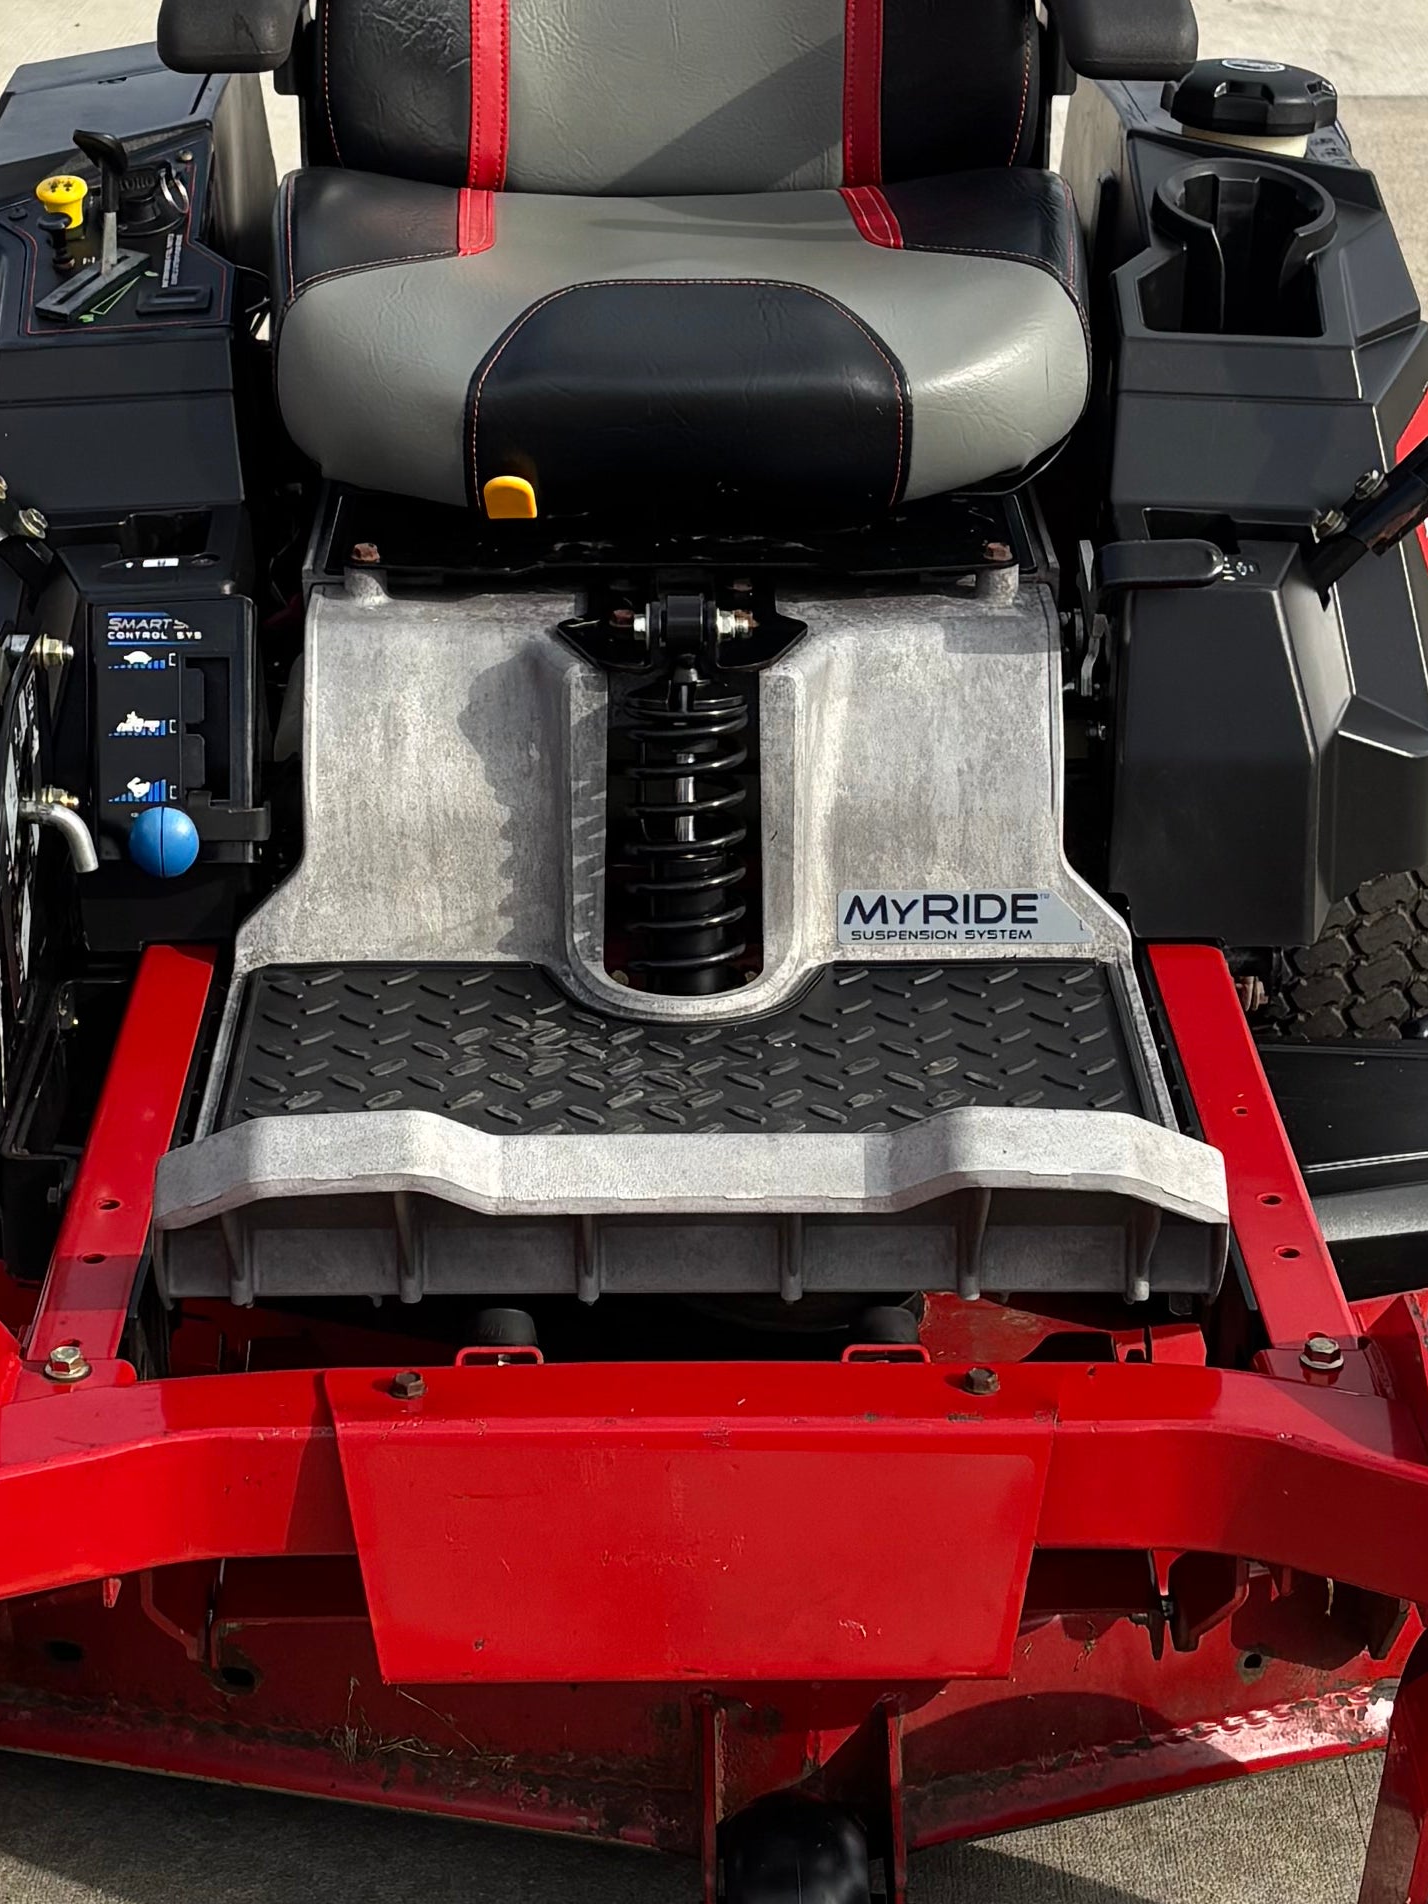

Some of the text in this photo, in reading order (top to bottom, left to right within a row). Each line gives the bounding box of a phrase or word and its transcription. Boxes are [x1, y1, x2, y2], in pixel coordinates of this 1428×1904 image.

[108, 618, 173, 631] SMART
[107, 631, 169, 640] CONTROL
[851, 929, 1032, 941] SUSPENSION SYSTEM
